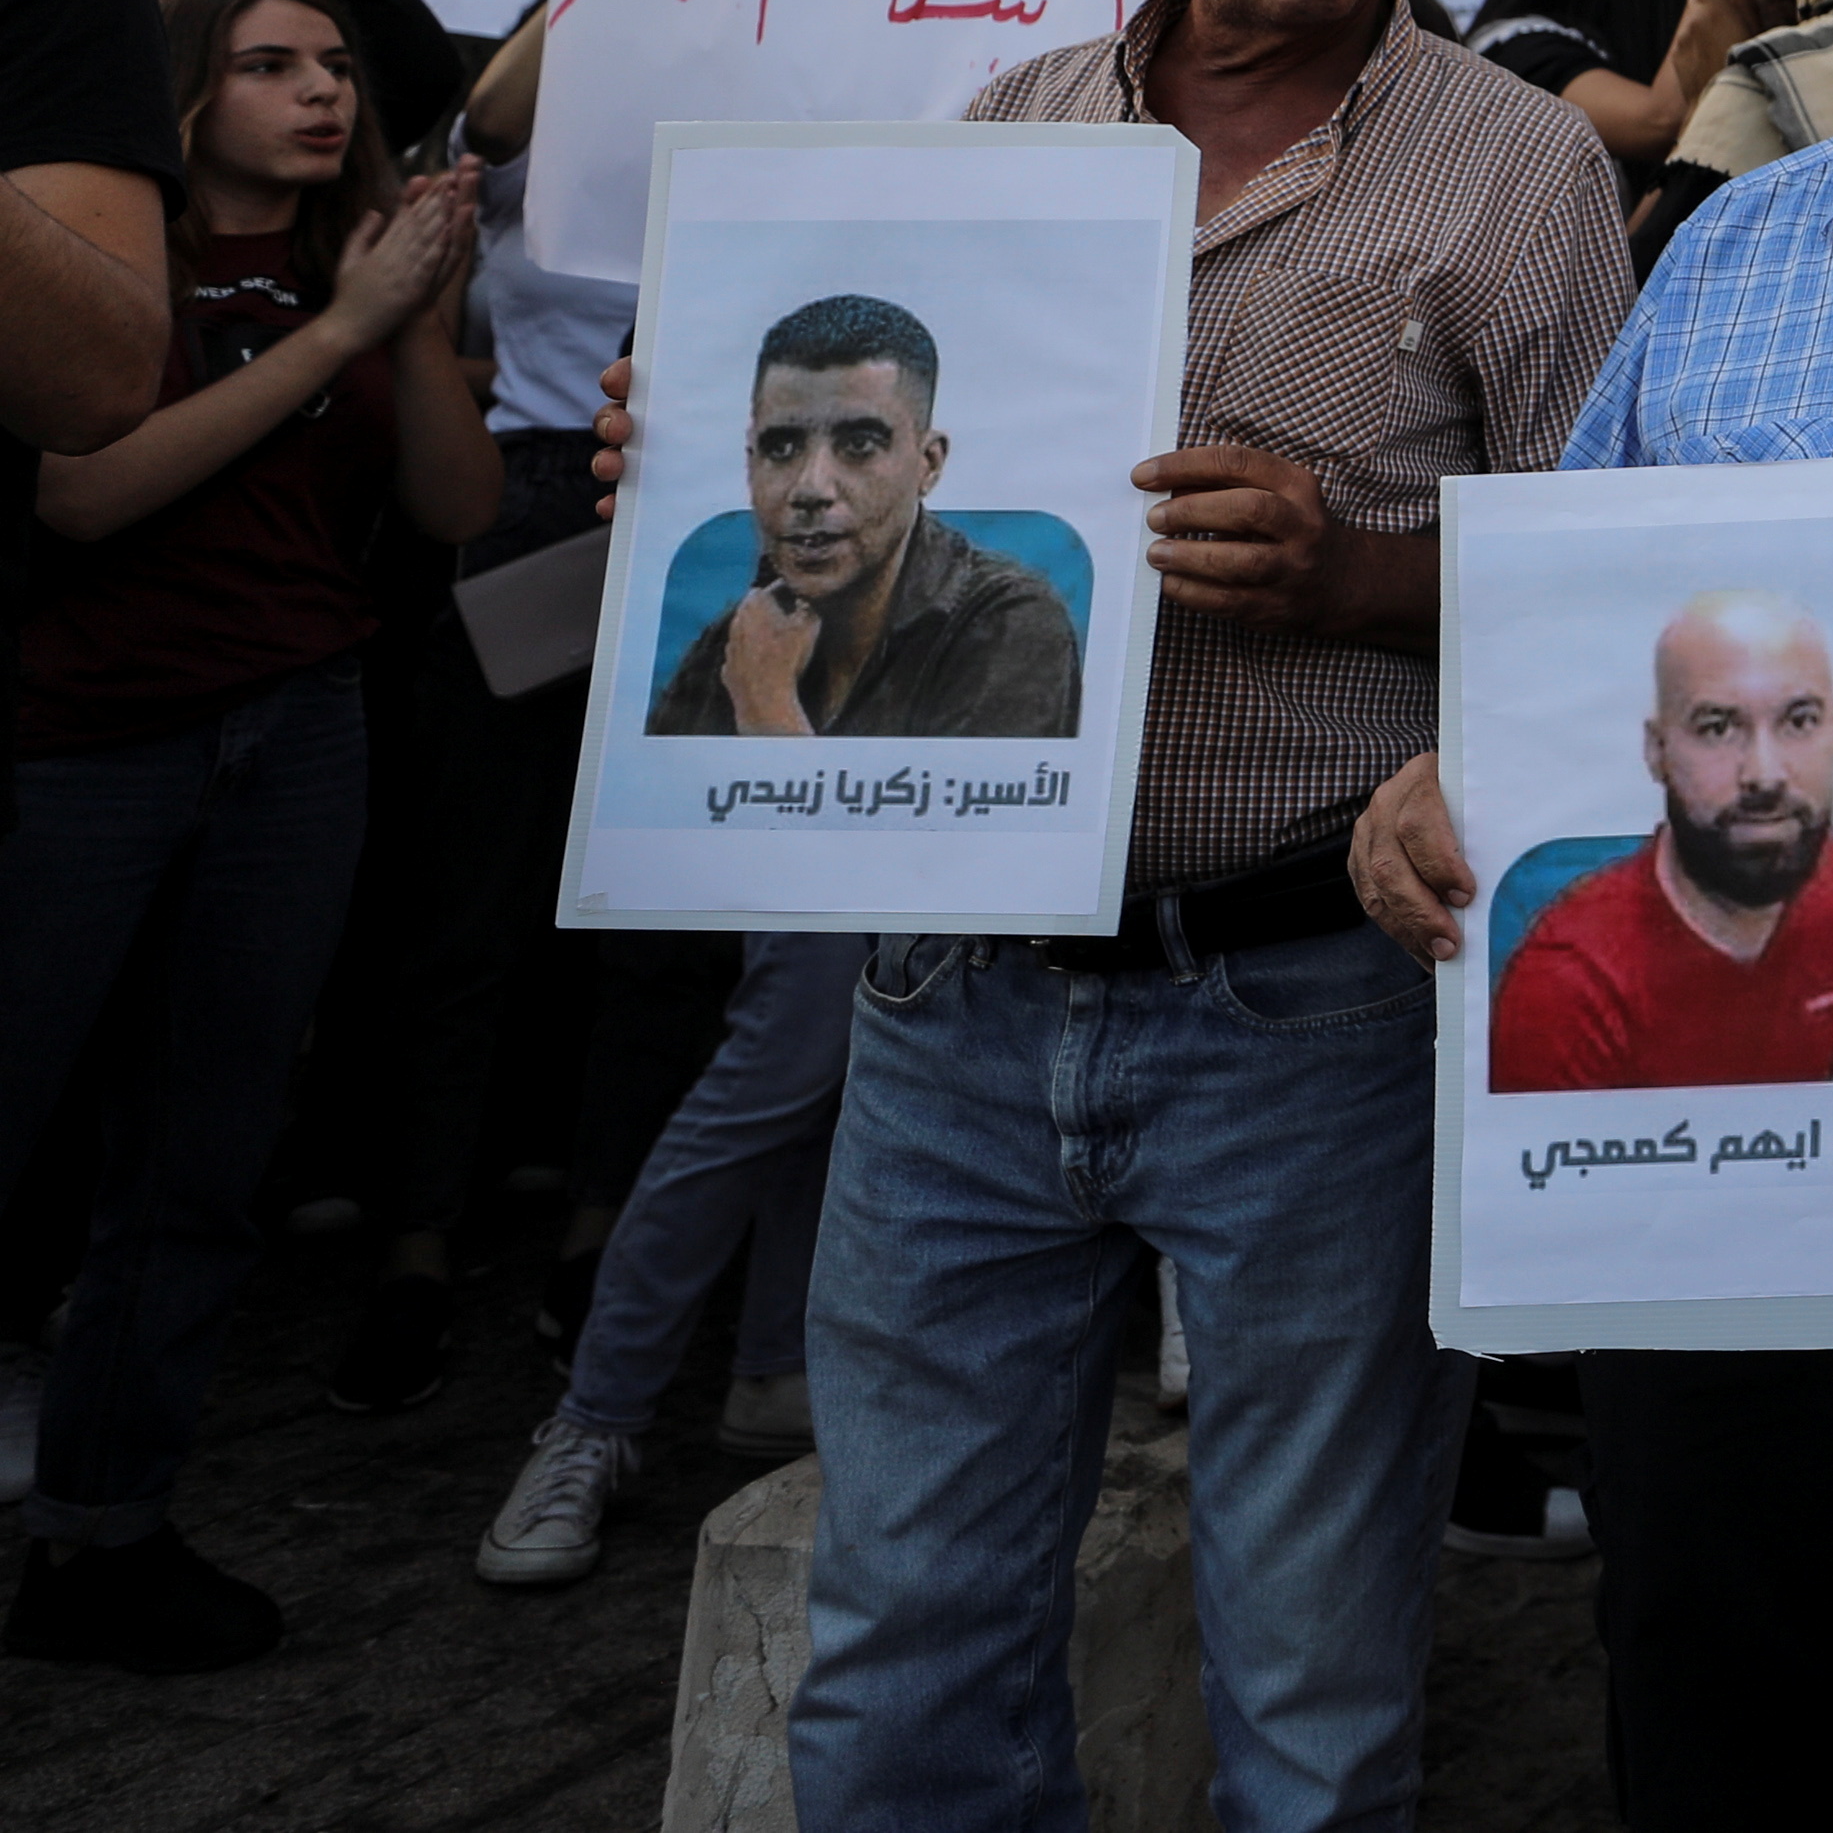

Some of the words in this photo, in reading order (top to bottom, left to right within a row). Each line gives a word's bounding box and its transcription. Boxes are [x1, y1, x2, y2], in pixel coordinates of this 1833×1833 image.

[706, 768, 826, 824] زبيدي
[834, 765, 933, 818] زكريا
[942, 761, 1072, 818] الأسير:
[1520, 1118, 1699, 1191] كممجي
[1709, 1117, 1822, 1175] ايهم
